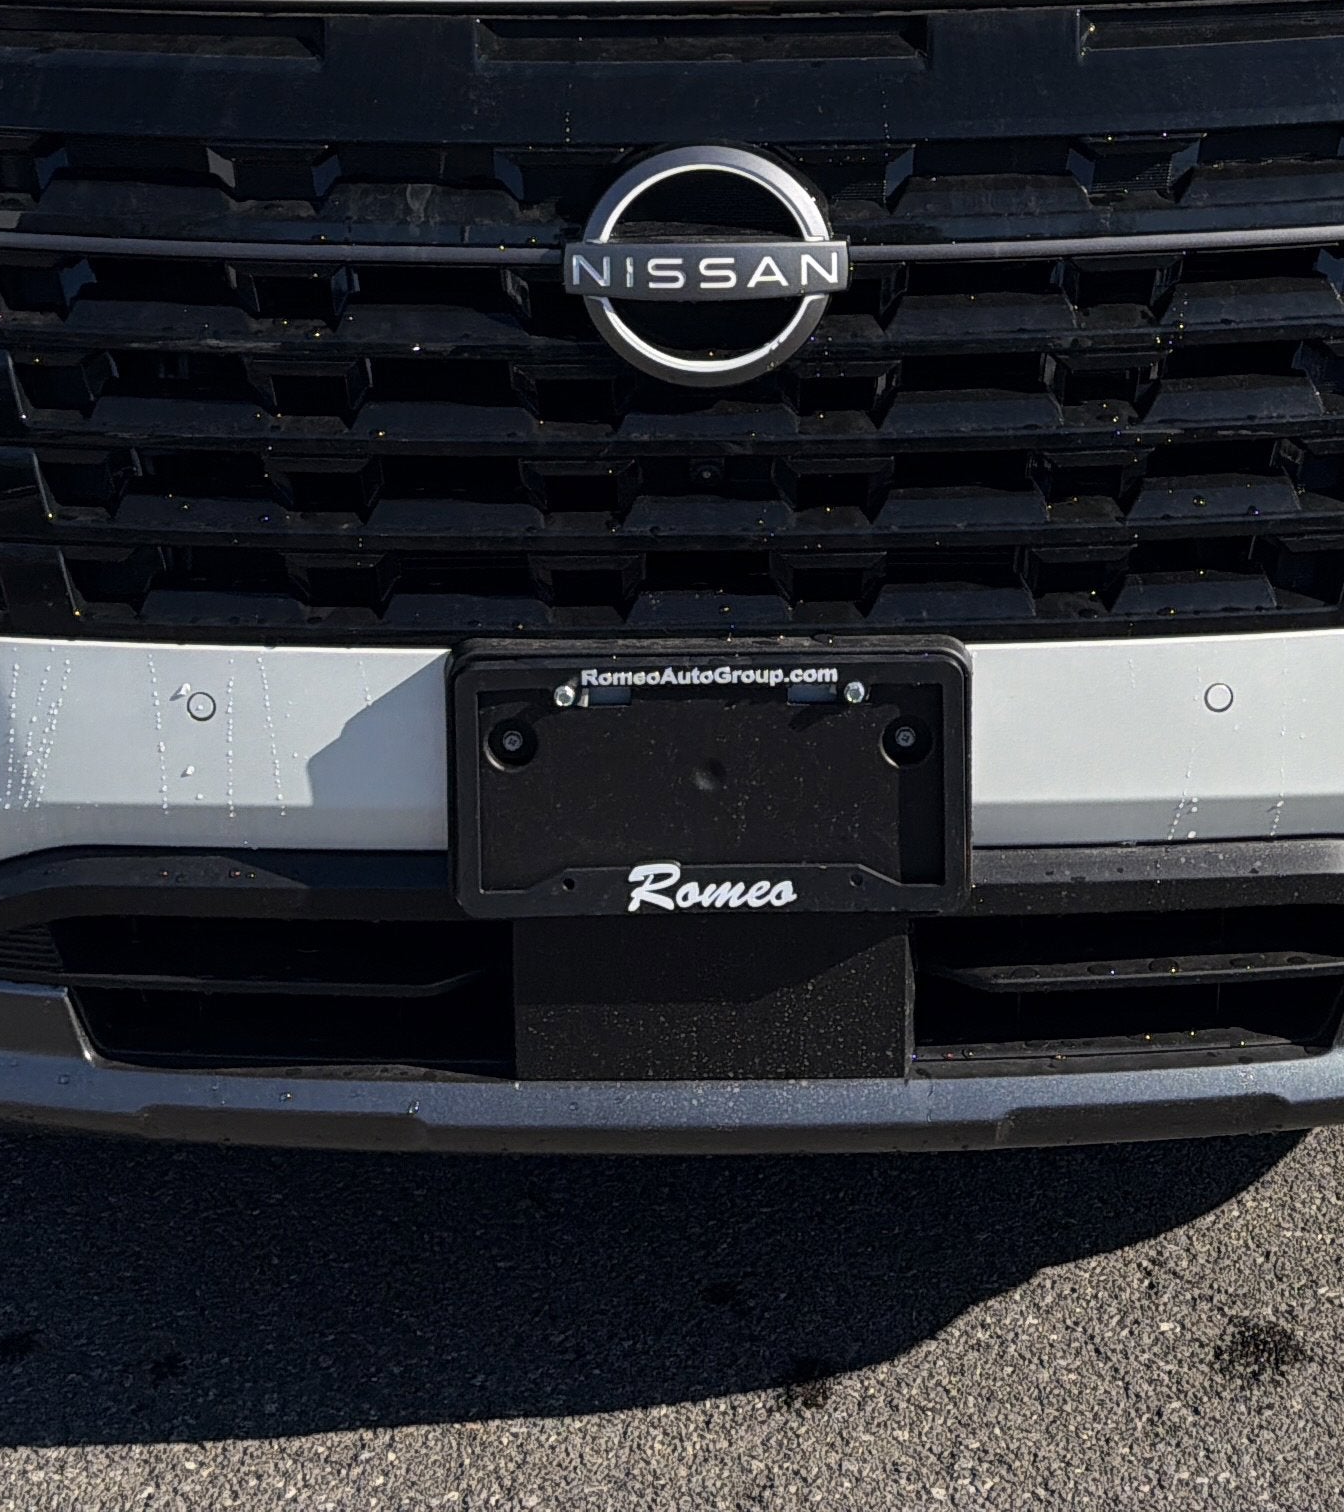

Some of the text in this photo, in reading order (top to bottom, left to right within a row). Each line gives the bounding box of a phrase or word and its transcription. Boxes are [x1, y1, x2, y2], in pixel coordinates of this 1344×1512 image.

[571, 251, 838, 289] NISSAN
[580, 666, 839, 687] RomeoAutoGroup.com
[628, 863, 798, 912] Romeo
